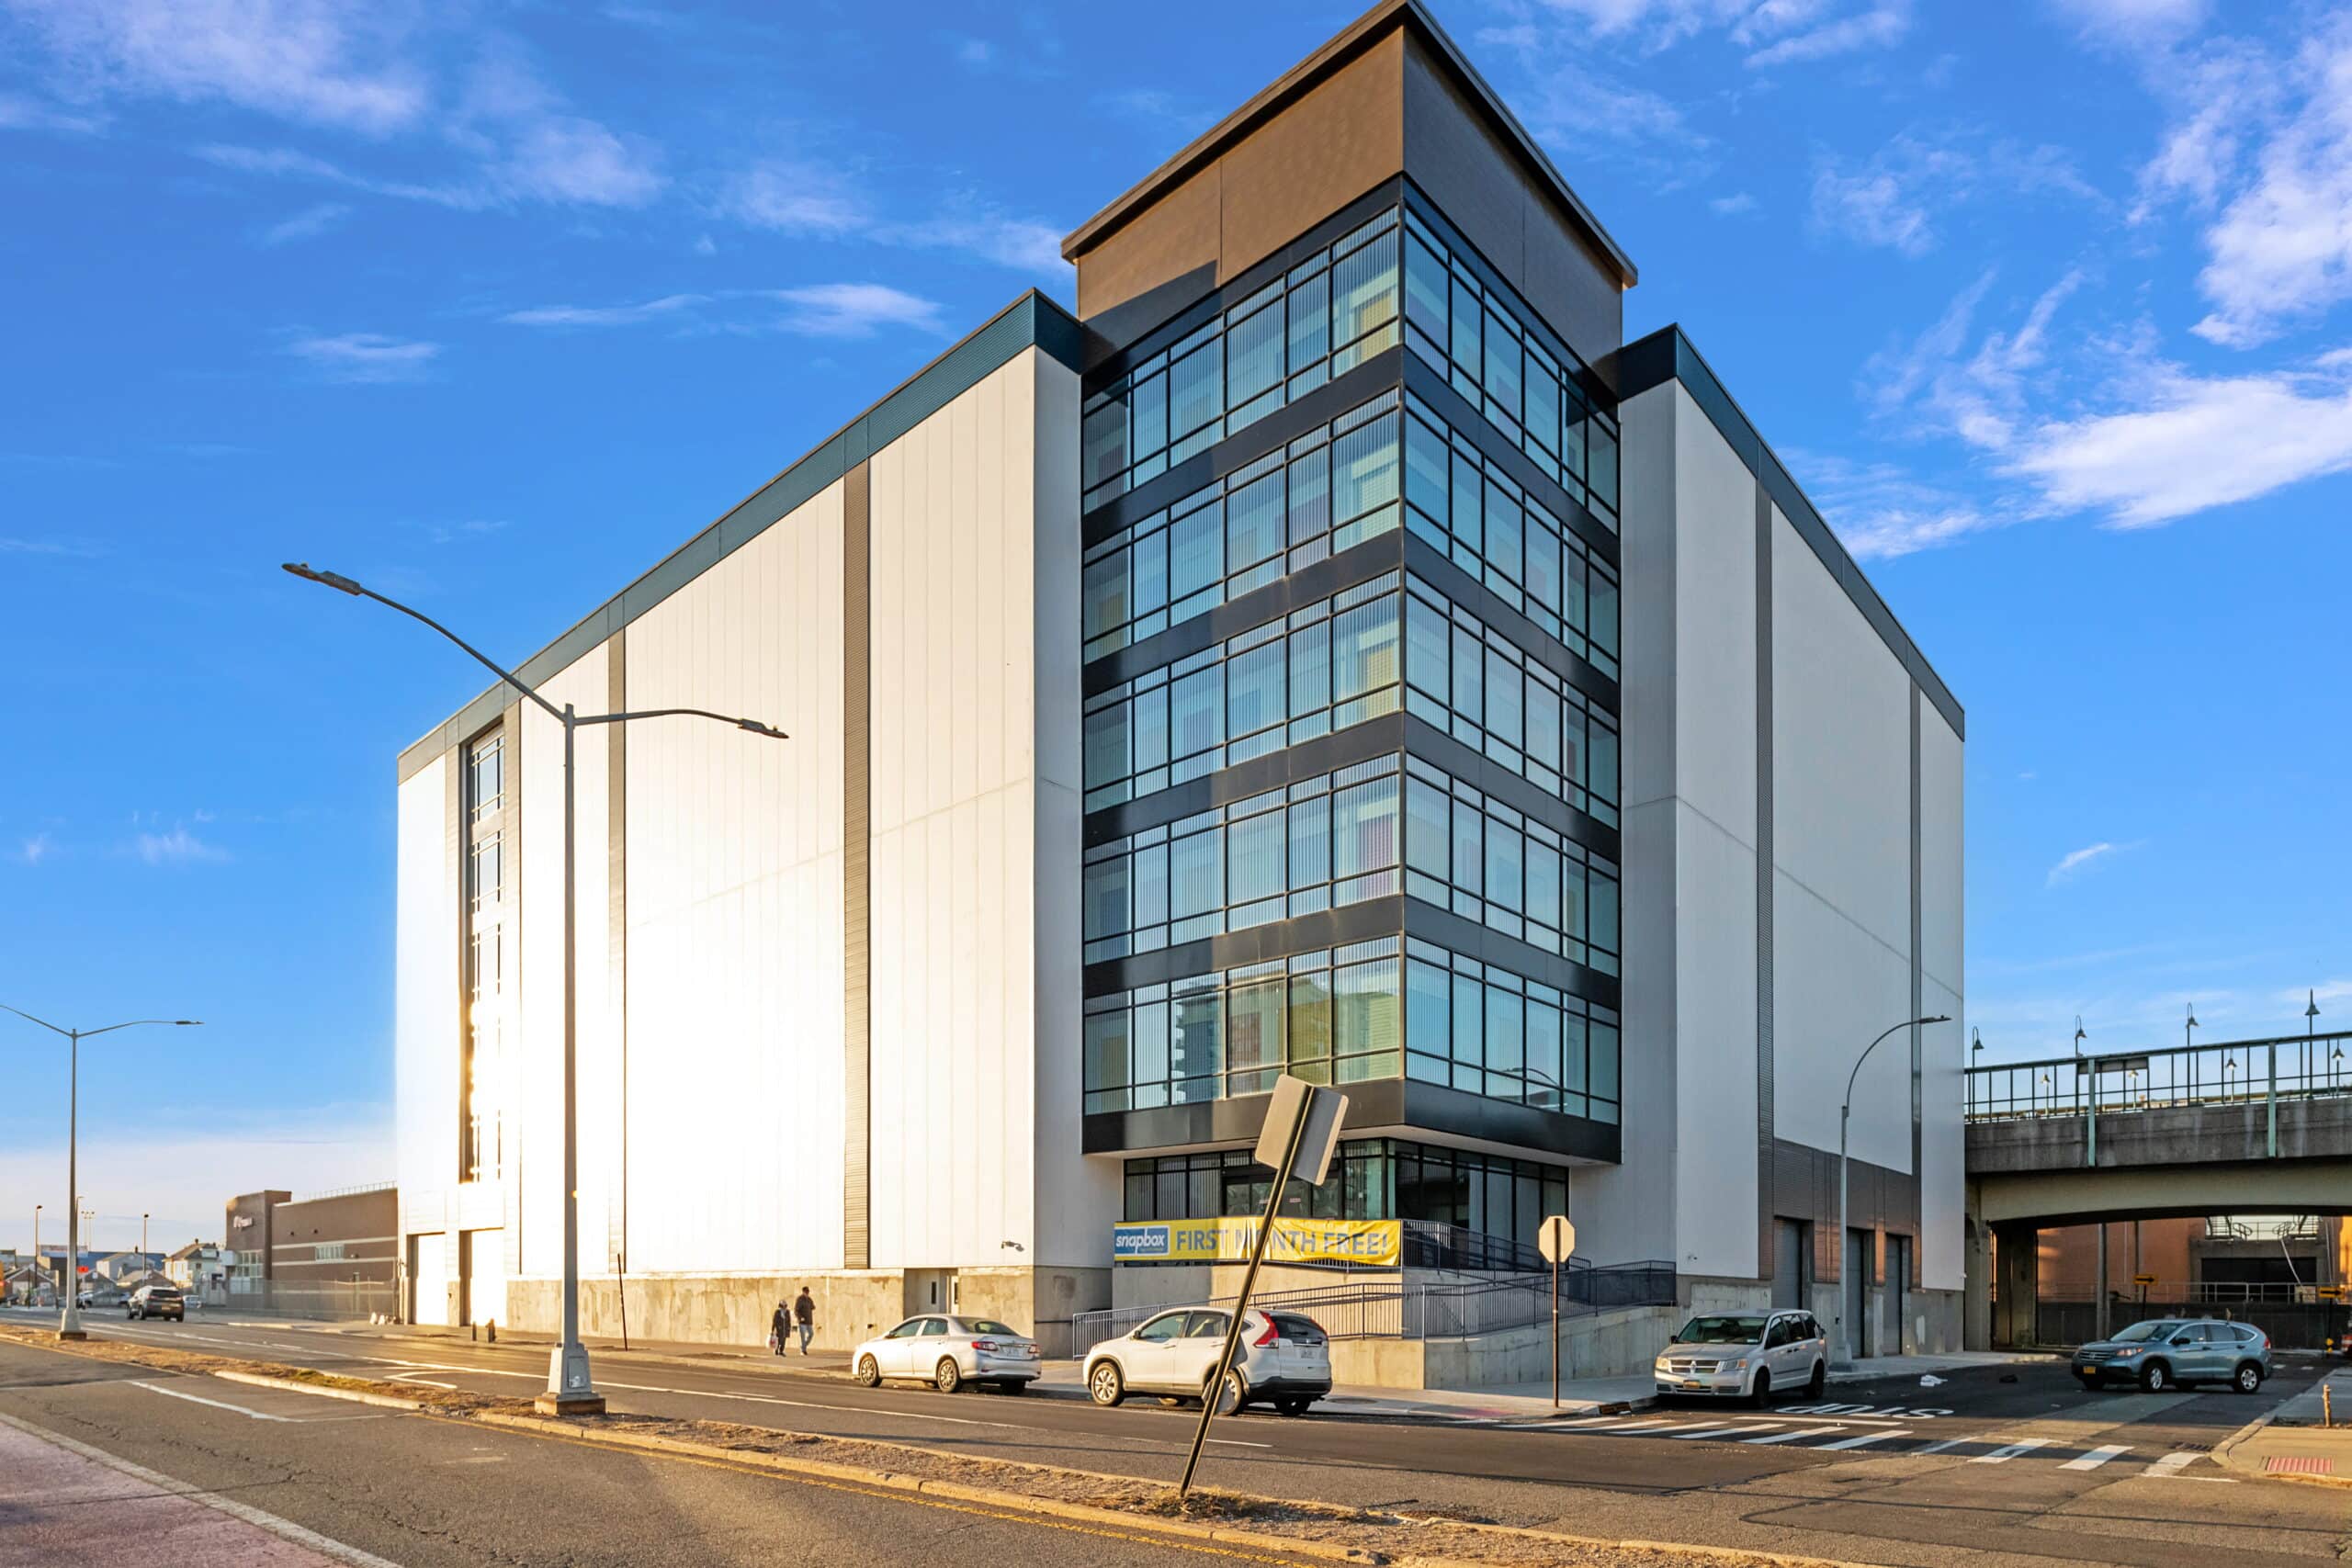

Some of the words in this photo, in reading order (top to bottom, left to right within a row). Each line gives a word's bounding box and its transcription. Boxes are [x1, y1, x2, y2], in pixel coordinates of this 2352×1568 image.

[1115, 1229, 1165, 1252] snapbox
[1176, 1228, 1227, 1251] FIRST
[1323, 1231, 1388, 1257] FREE!
[1775, 1403, 1954, 1418] STOP
